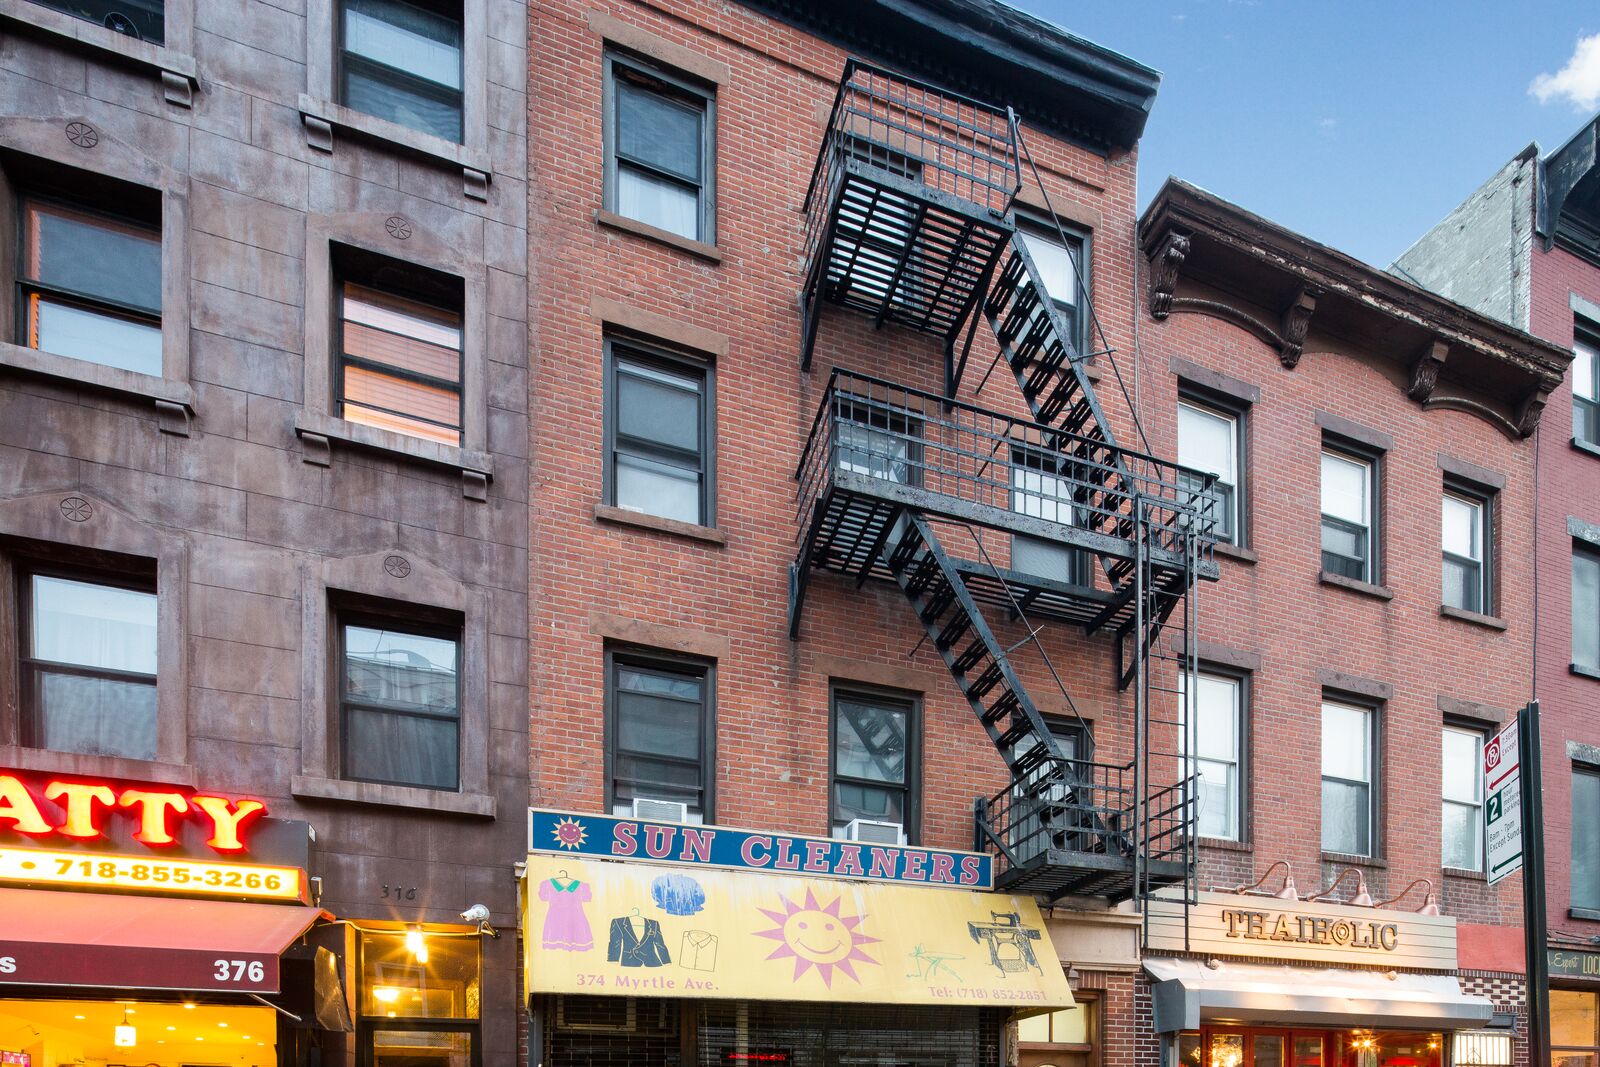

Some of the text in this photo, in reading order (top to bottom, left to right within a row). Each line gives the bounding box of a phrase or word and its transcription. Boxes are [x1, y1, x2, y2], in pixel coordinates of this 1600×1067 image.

[1489, 796, 1499, 822] 2
[1503, 791, 1520, 806] metere
[1489, 826, 1520, 853] Except Sund
[611, 822, 981, 885] SUN CLEANERS
[53, 858, 282, 891] 718-855-3266
[1222, 909, 1399, 951] THAIHOLIC
[213, 959, 265, 983] 376
[1582, 954, 1600, 976] LOC
[576, 974, 720, 991] 374 Myrtle Ave.
[928, 986, 1048, 1001] Tel: (718) 852-2851
